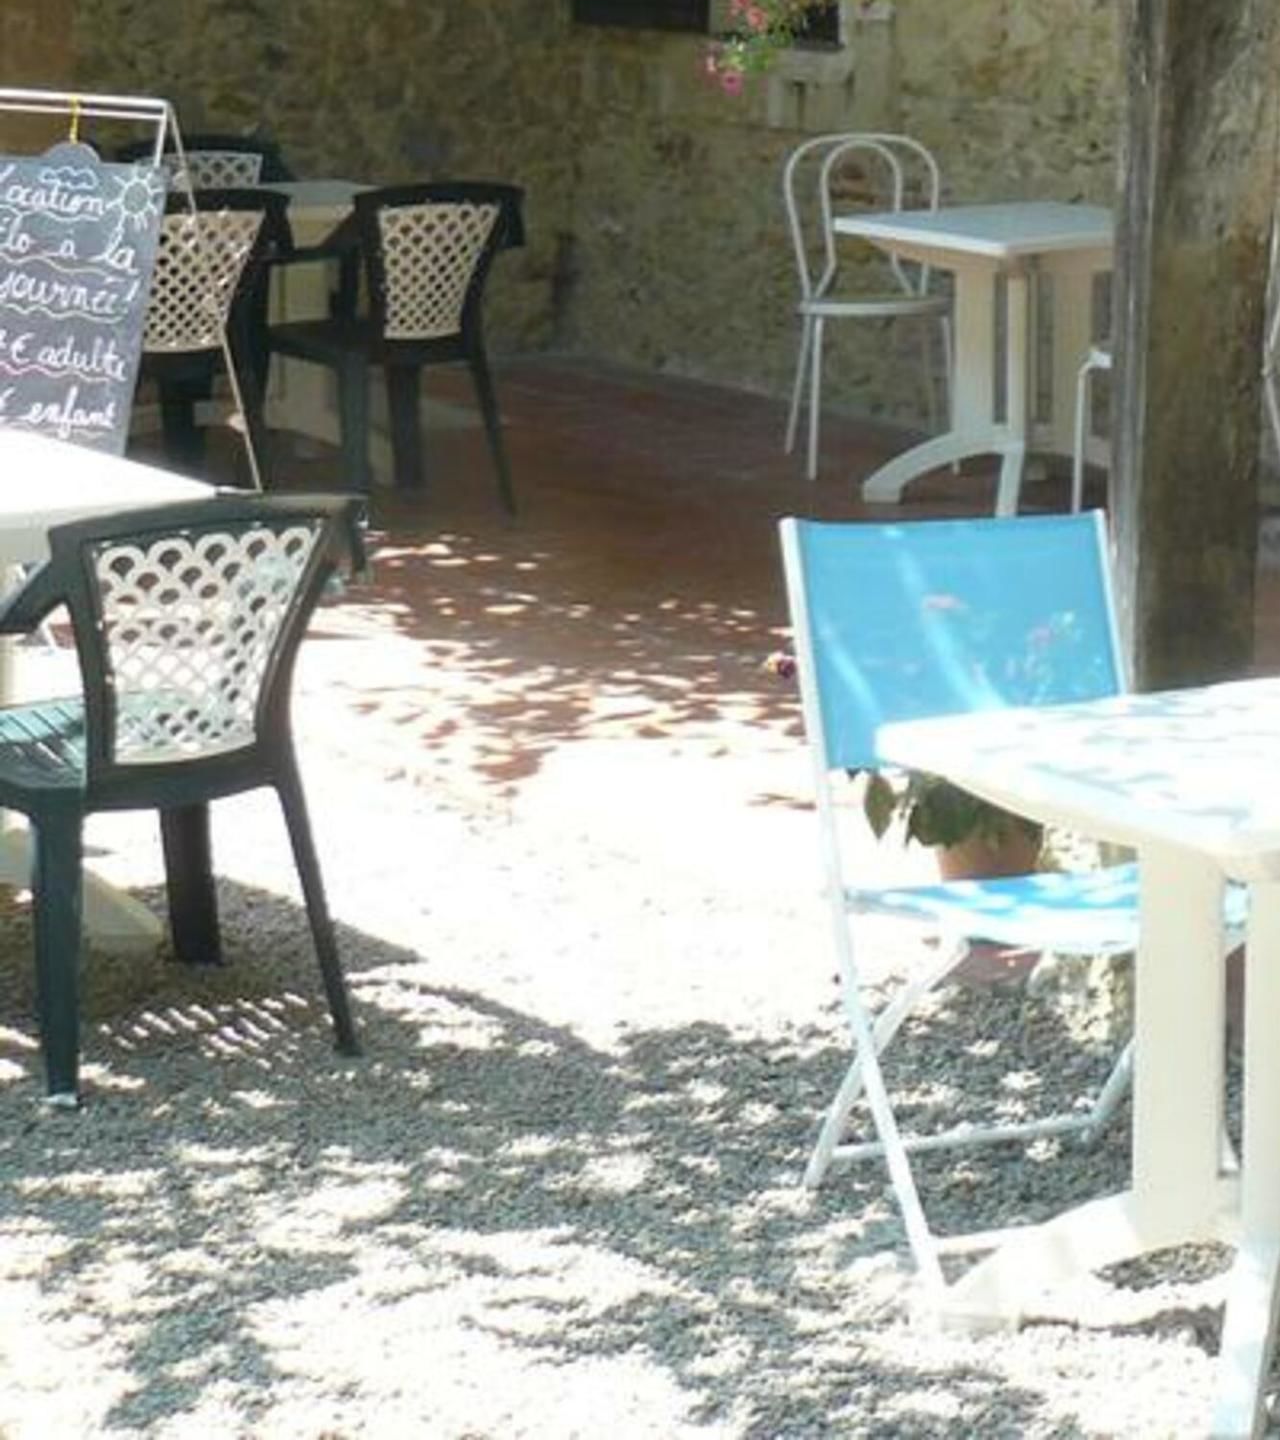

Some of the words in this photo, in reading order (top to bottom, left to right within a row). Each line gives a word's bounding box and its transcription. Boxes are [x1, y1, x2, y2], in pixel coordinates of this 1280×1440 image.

[92, 226, 140, 274] la
[37, 335, 127, 382] adulte
[25, 385, 117, 439] enfant
